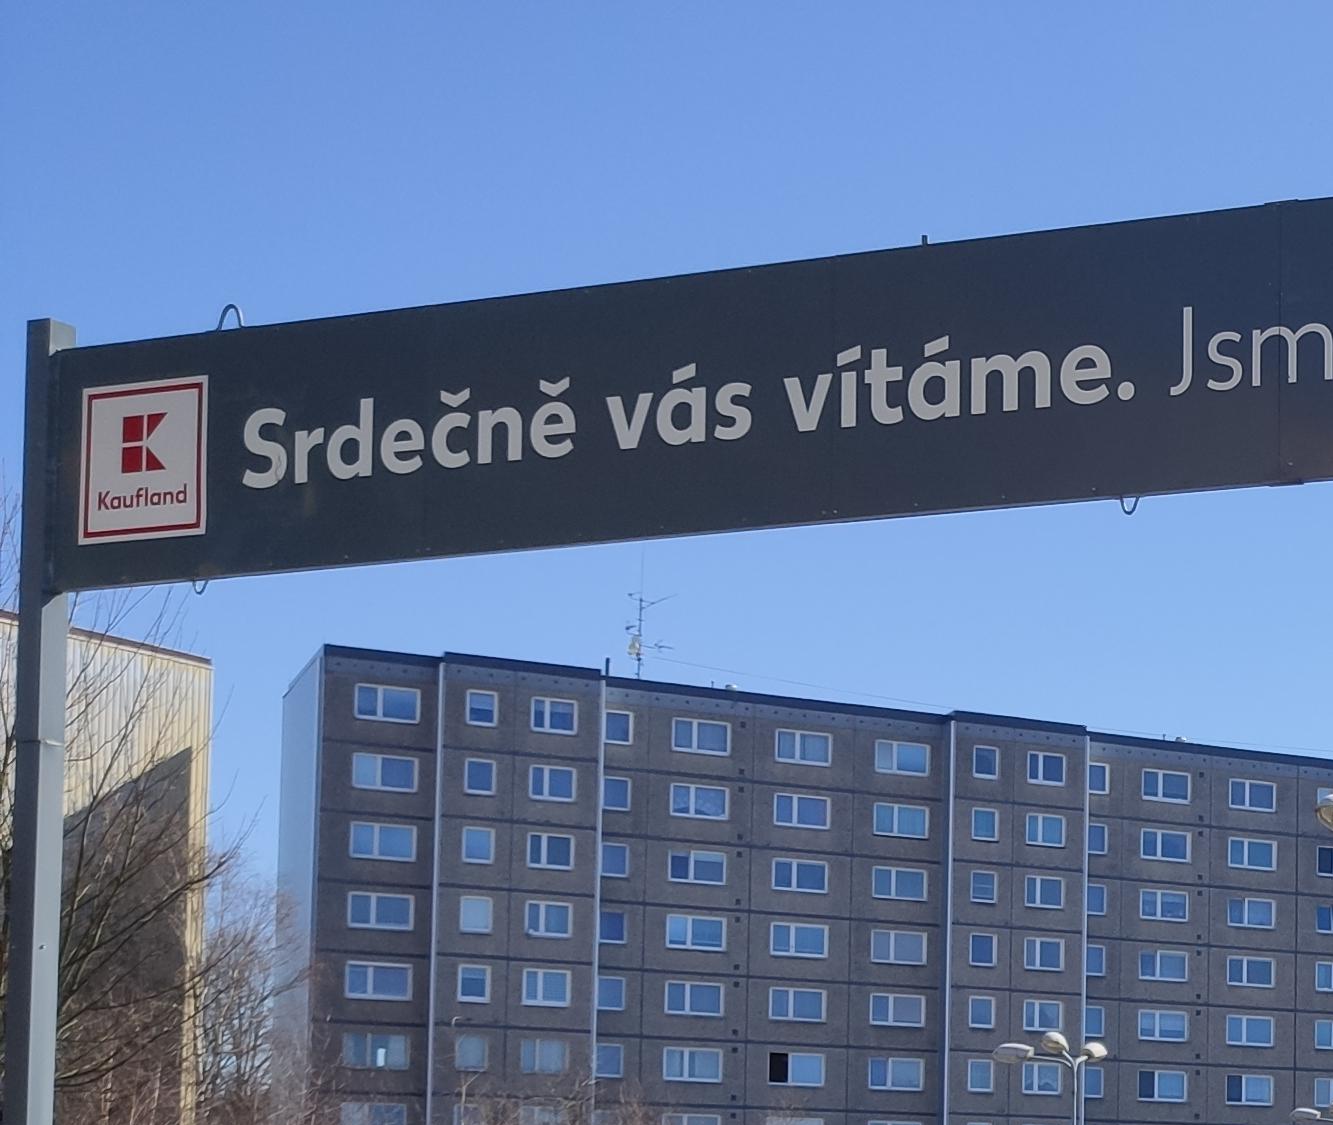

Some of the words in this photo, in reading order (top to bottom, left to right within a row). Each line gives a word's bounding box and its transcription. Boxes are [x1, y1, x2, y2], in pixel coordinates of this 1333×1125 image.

[242, 376, 576, 489] Srdečně
[605, 363, 752, 450] vás
[783, 335, 1135, 432] vítáme.
[97, 483, 187, 511] Kaufland
